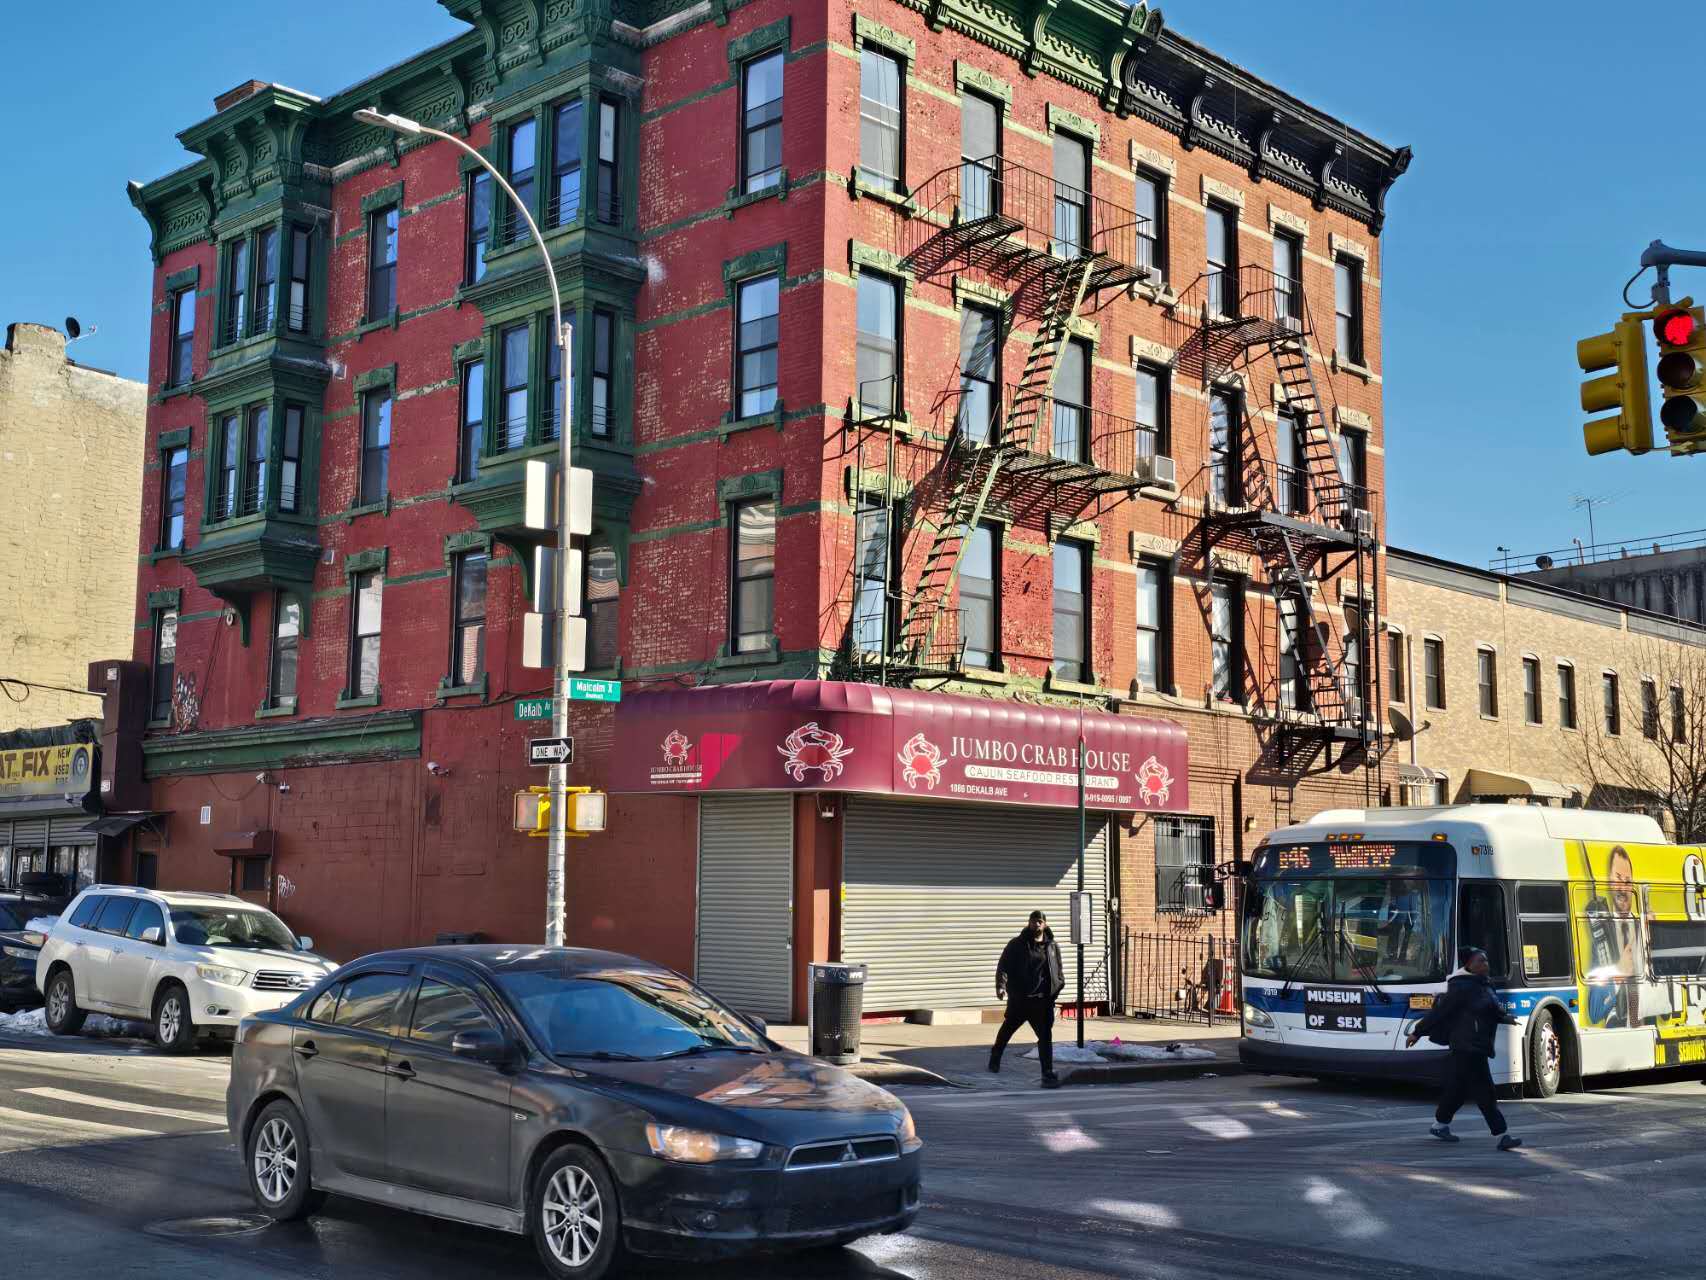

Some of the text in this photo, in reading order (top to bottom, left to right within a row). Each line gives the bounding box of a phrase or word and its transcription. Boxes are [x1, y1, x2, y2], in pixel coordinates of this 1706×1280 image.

[576, 681, 613, 694] Malcolm X
[518, 703, 543, 718] DeKalb
[57, 747, 71, 759] NEW
[535, 746, 567, 757] ONE WAY
[950, 736, 1017, 763] JUMBO
[1022, 743, 1067, 768] CRAB
[22, 750, 51, 777] FIX
[969, 766, 1115, 788] CAJUN SEAFOOD RESTURANT
[966, 785, 994, 796] DEKALB
[994, 787, 1009, 797] AVE
[1279, 846, 1311, 869] B46
[1307, 990, 1361, 1004] MUSEUM
[1308, 1014, 1363, 1029] OF SEX
